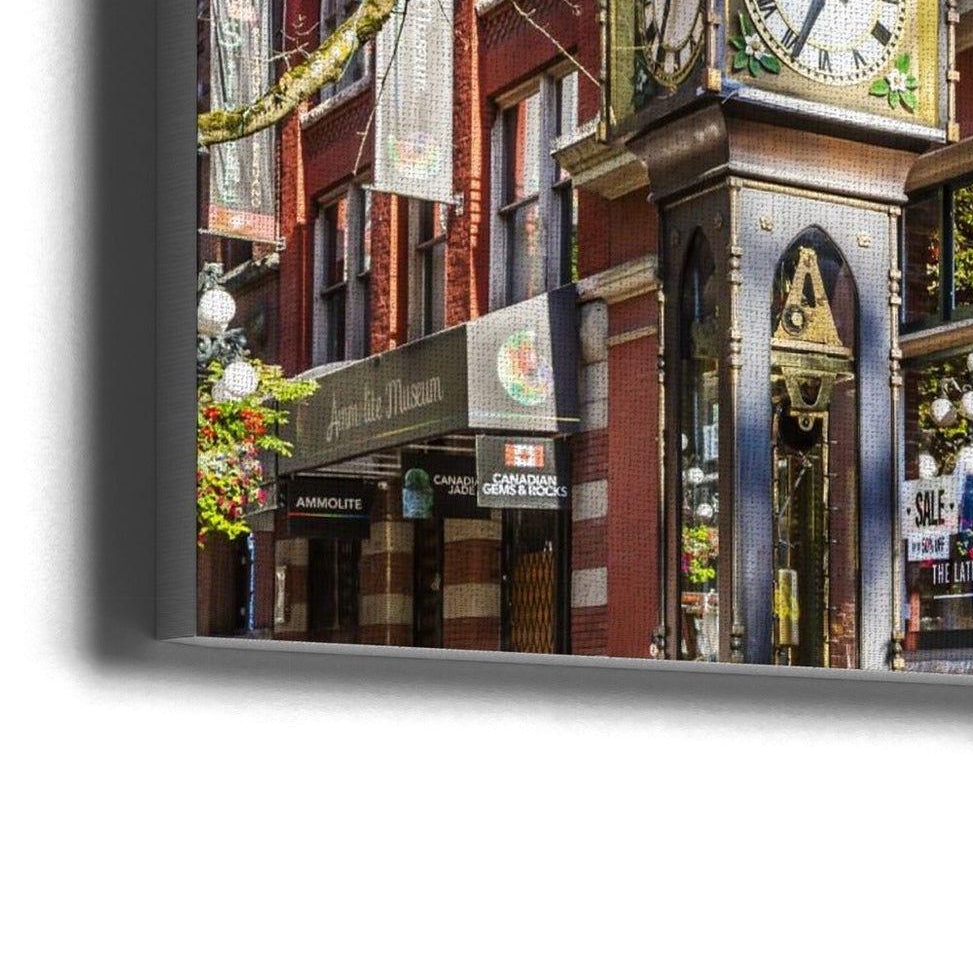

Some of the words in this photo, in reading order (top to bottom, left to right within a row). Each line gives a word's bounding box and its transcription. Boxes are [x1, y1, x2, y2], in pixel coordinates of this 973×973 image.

[385, 376, 444, 419] Museum
[492, 473, 557, 487] CANADIAN
[482, 483, 517, 496] GEMS
[518, 486, 527, 496] &
[528, 486, 568, 498] ROCKS
[295, 497, 363, 511] AMMOLITE
[915, 490, 945, 528] SALE
[932, 563, 950, 585] THE
